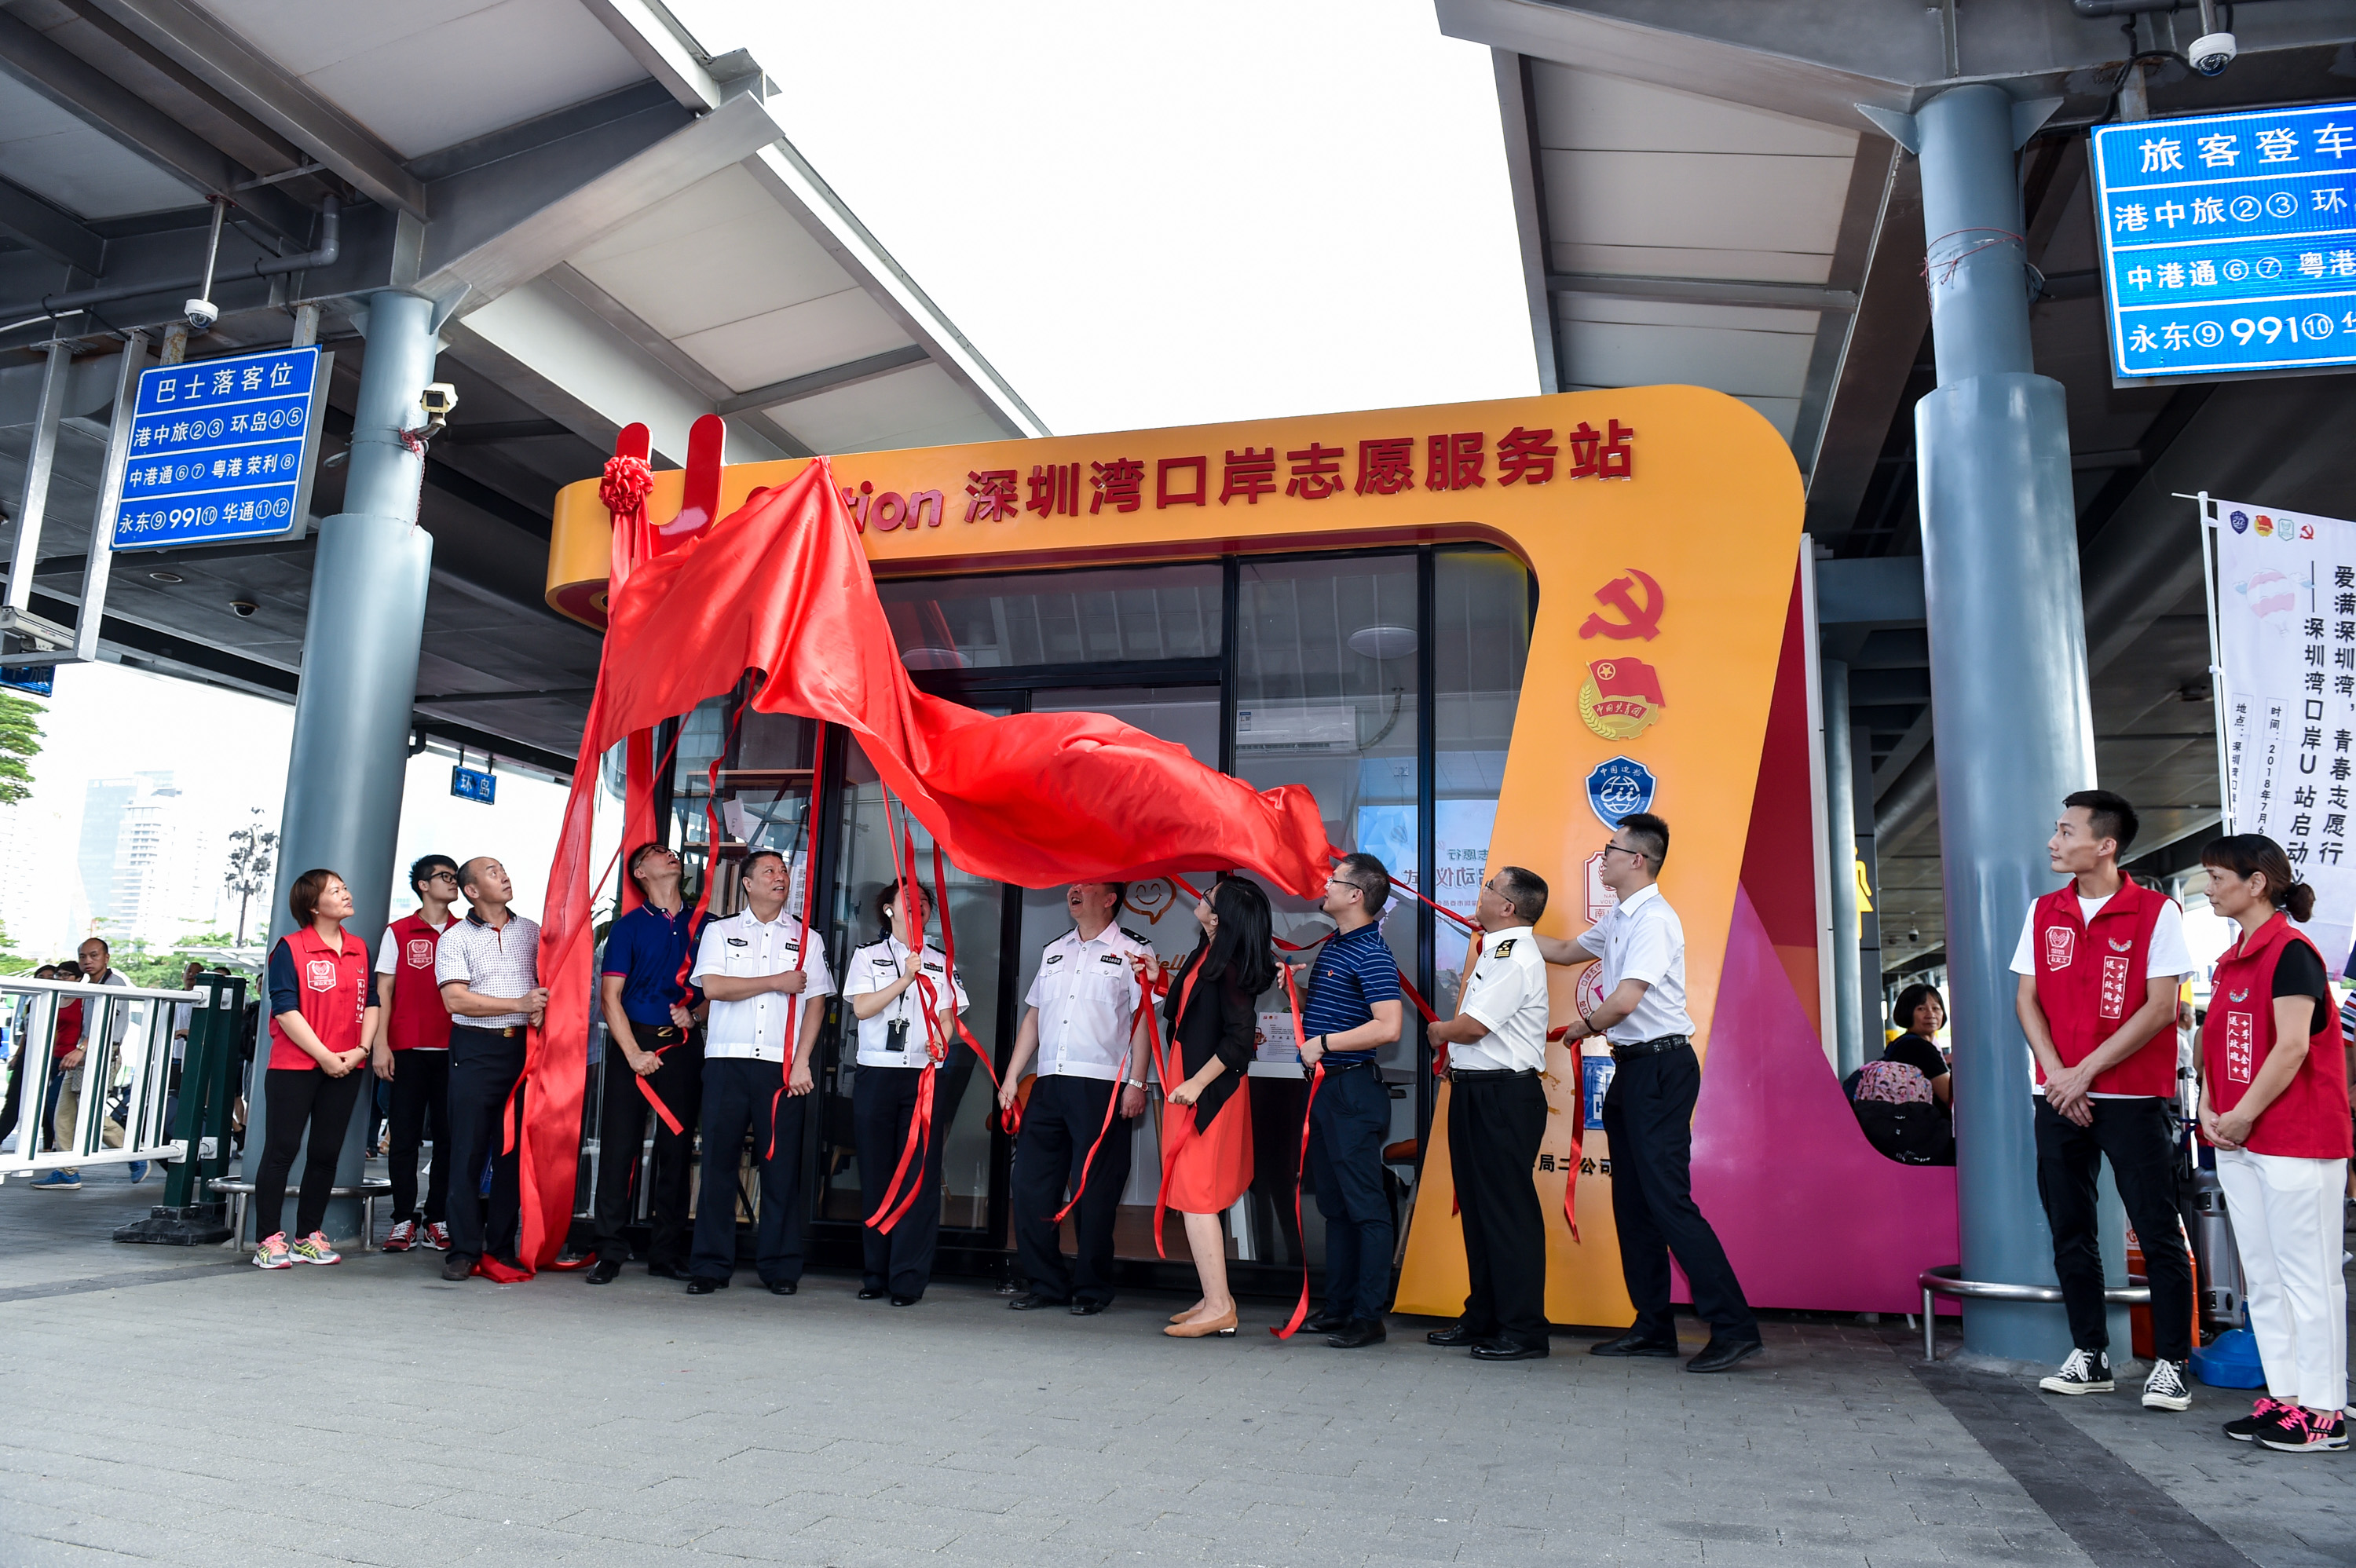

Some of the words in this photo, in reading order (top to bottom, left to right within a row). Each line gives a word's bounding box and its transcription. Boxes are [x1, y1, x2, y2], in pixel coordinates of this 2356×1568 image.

[156, 362, 294, 404] 巴士落客位
[964, 418, 1634, 524] 深圳湾口岸志愿服务站
[460, 774, 490, 797] 环岛
